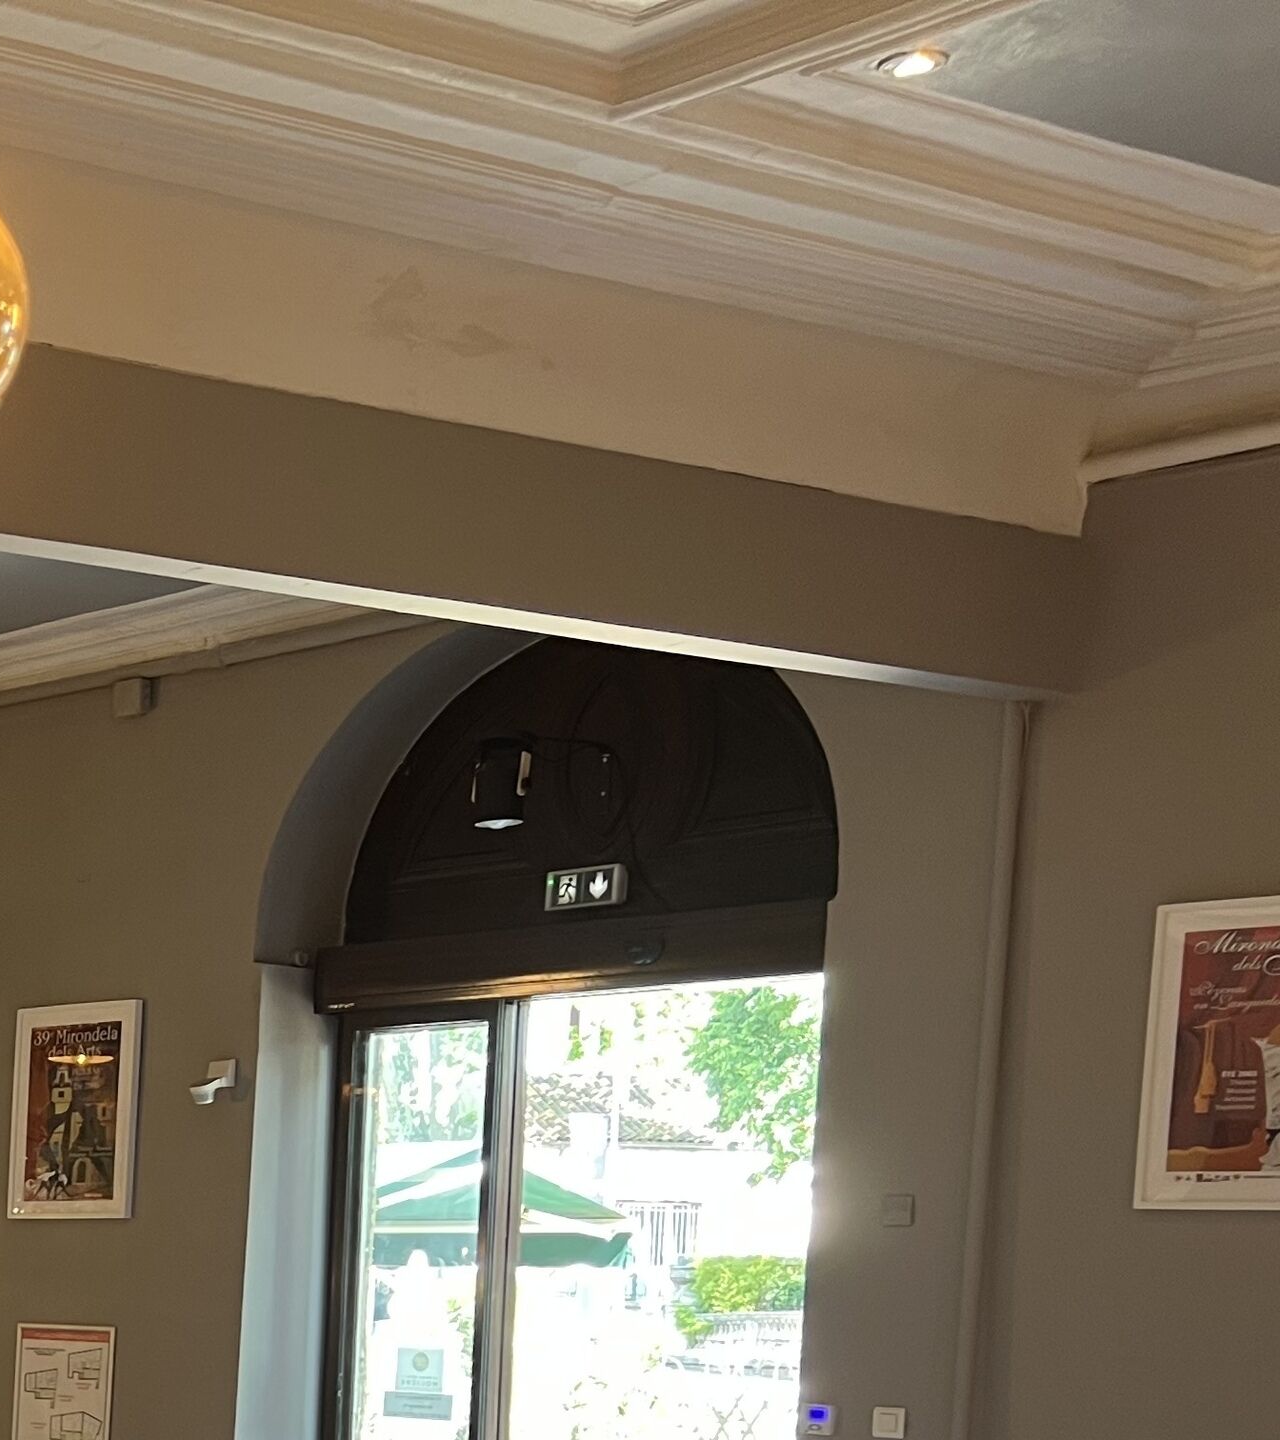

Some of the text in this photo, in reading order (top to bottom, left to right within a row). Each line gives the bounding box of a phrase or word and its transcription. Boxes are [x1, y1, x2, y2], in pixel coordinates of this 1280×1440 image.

[1231, 954, 1262, 971] dels
[55, 1025, 119, 1045] Mirondela
[77, 1044, 102, 1056] Arts
